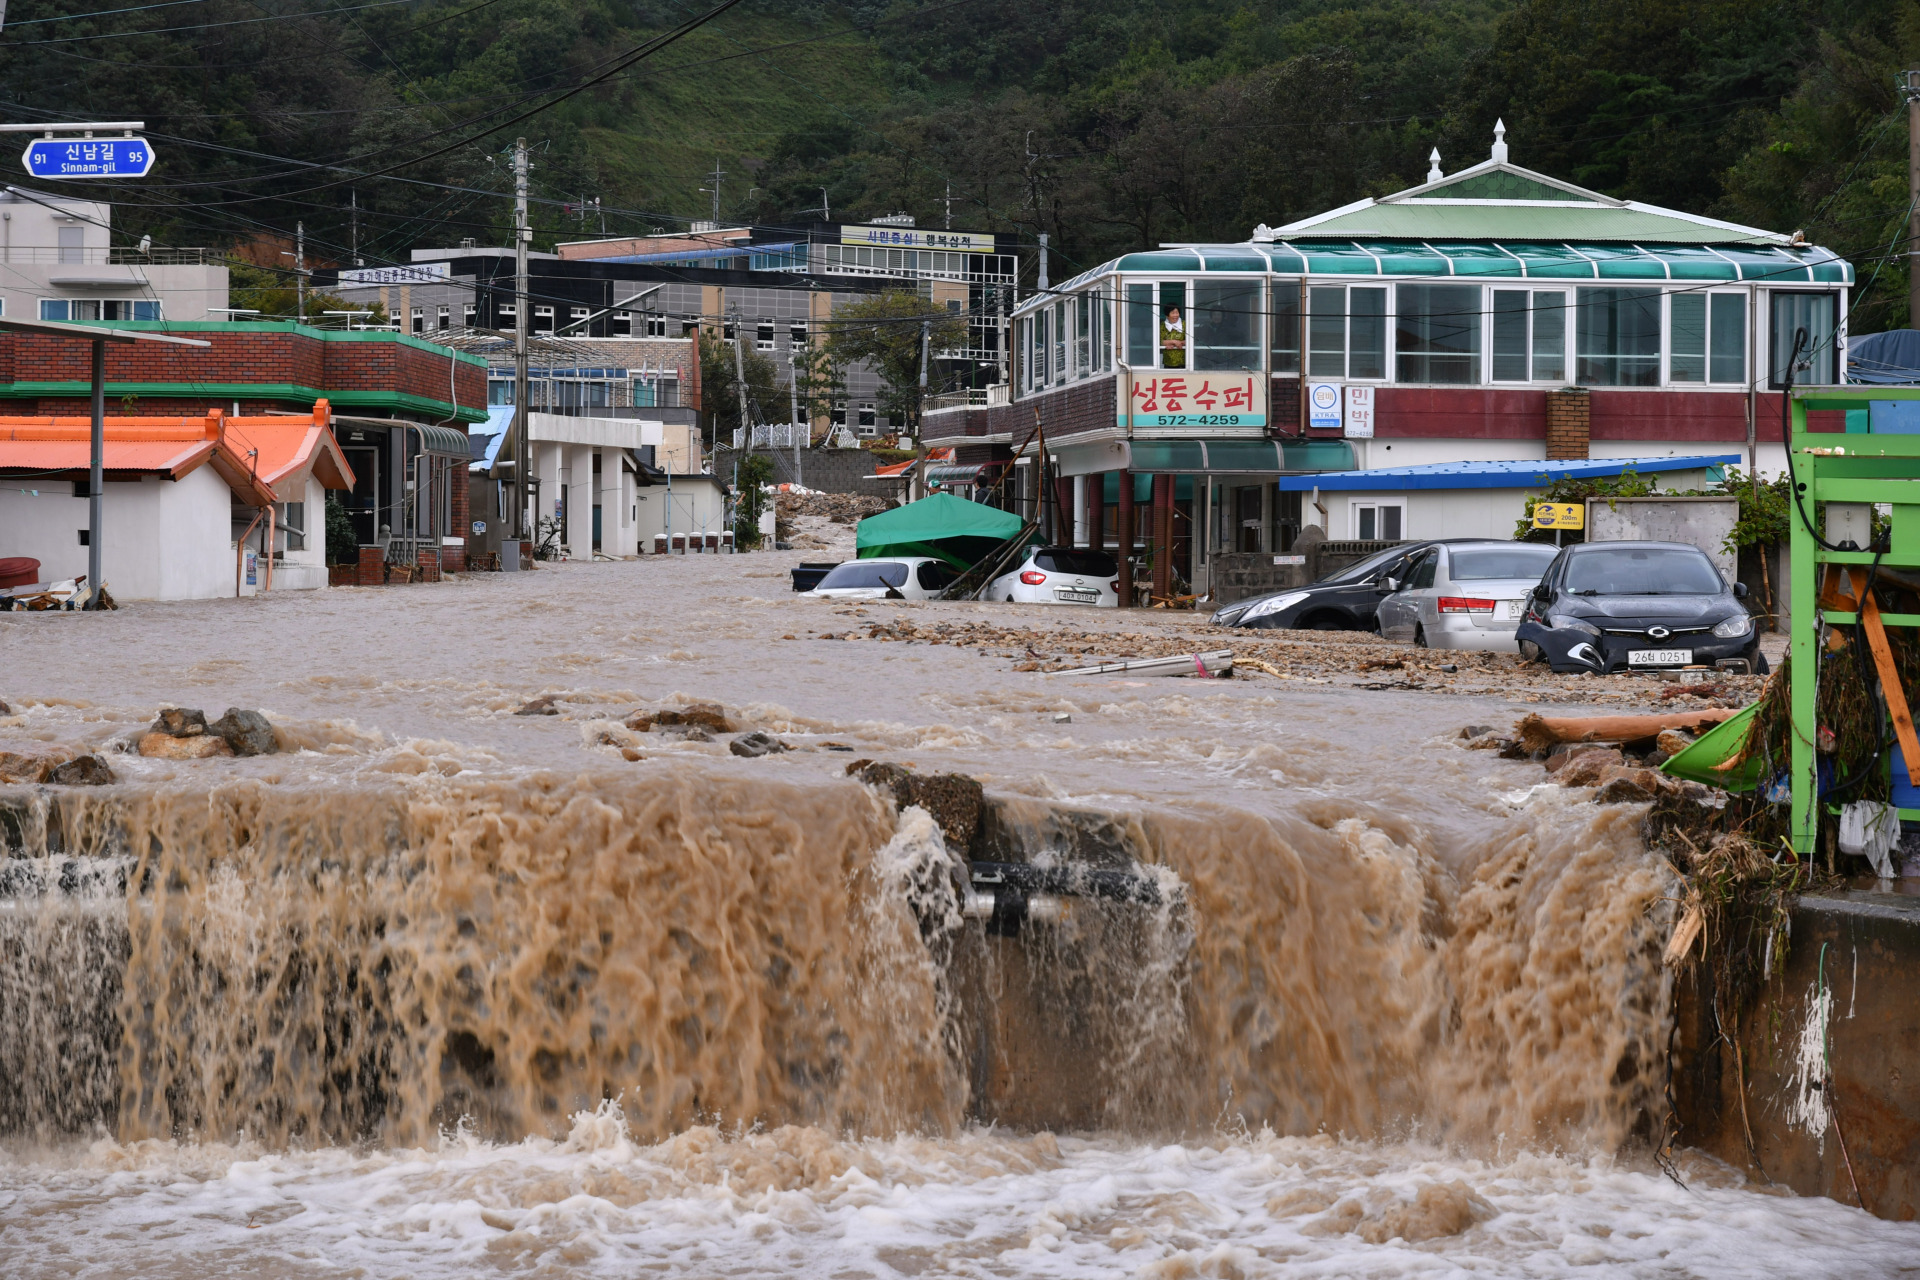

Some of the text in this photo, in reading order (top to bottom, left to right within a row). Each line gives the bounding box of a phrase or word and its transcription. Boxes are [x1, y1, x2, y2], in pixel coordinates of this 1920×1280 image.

[66, 143, 115, 161] 신남길
[128, 151, 143, 163] 95
[34, 153, 47, 165] 91
[61, 162, 116, 173] Sinnam-gil
[926, 234, 971, 249] 행복삼척
[1132, 377, 1253, 413] 성동수퍼
[1316, 391, 1334, 401] 담배
[1351, 388, 1370, 428] 민박
[1157, 414, 1240, 426] 572-4259
[1077, 593, 1092, 601] 0104
[1659, 651, 1686, 662] 0251
